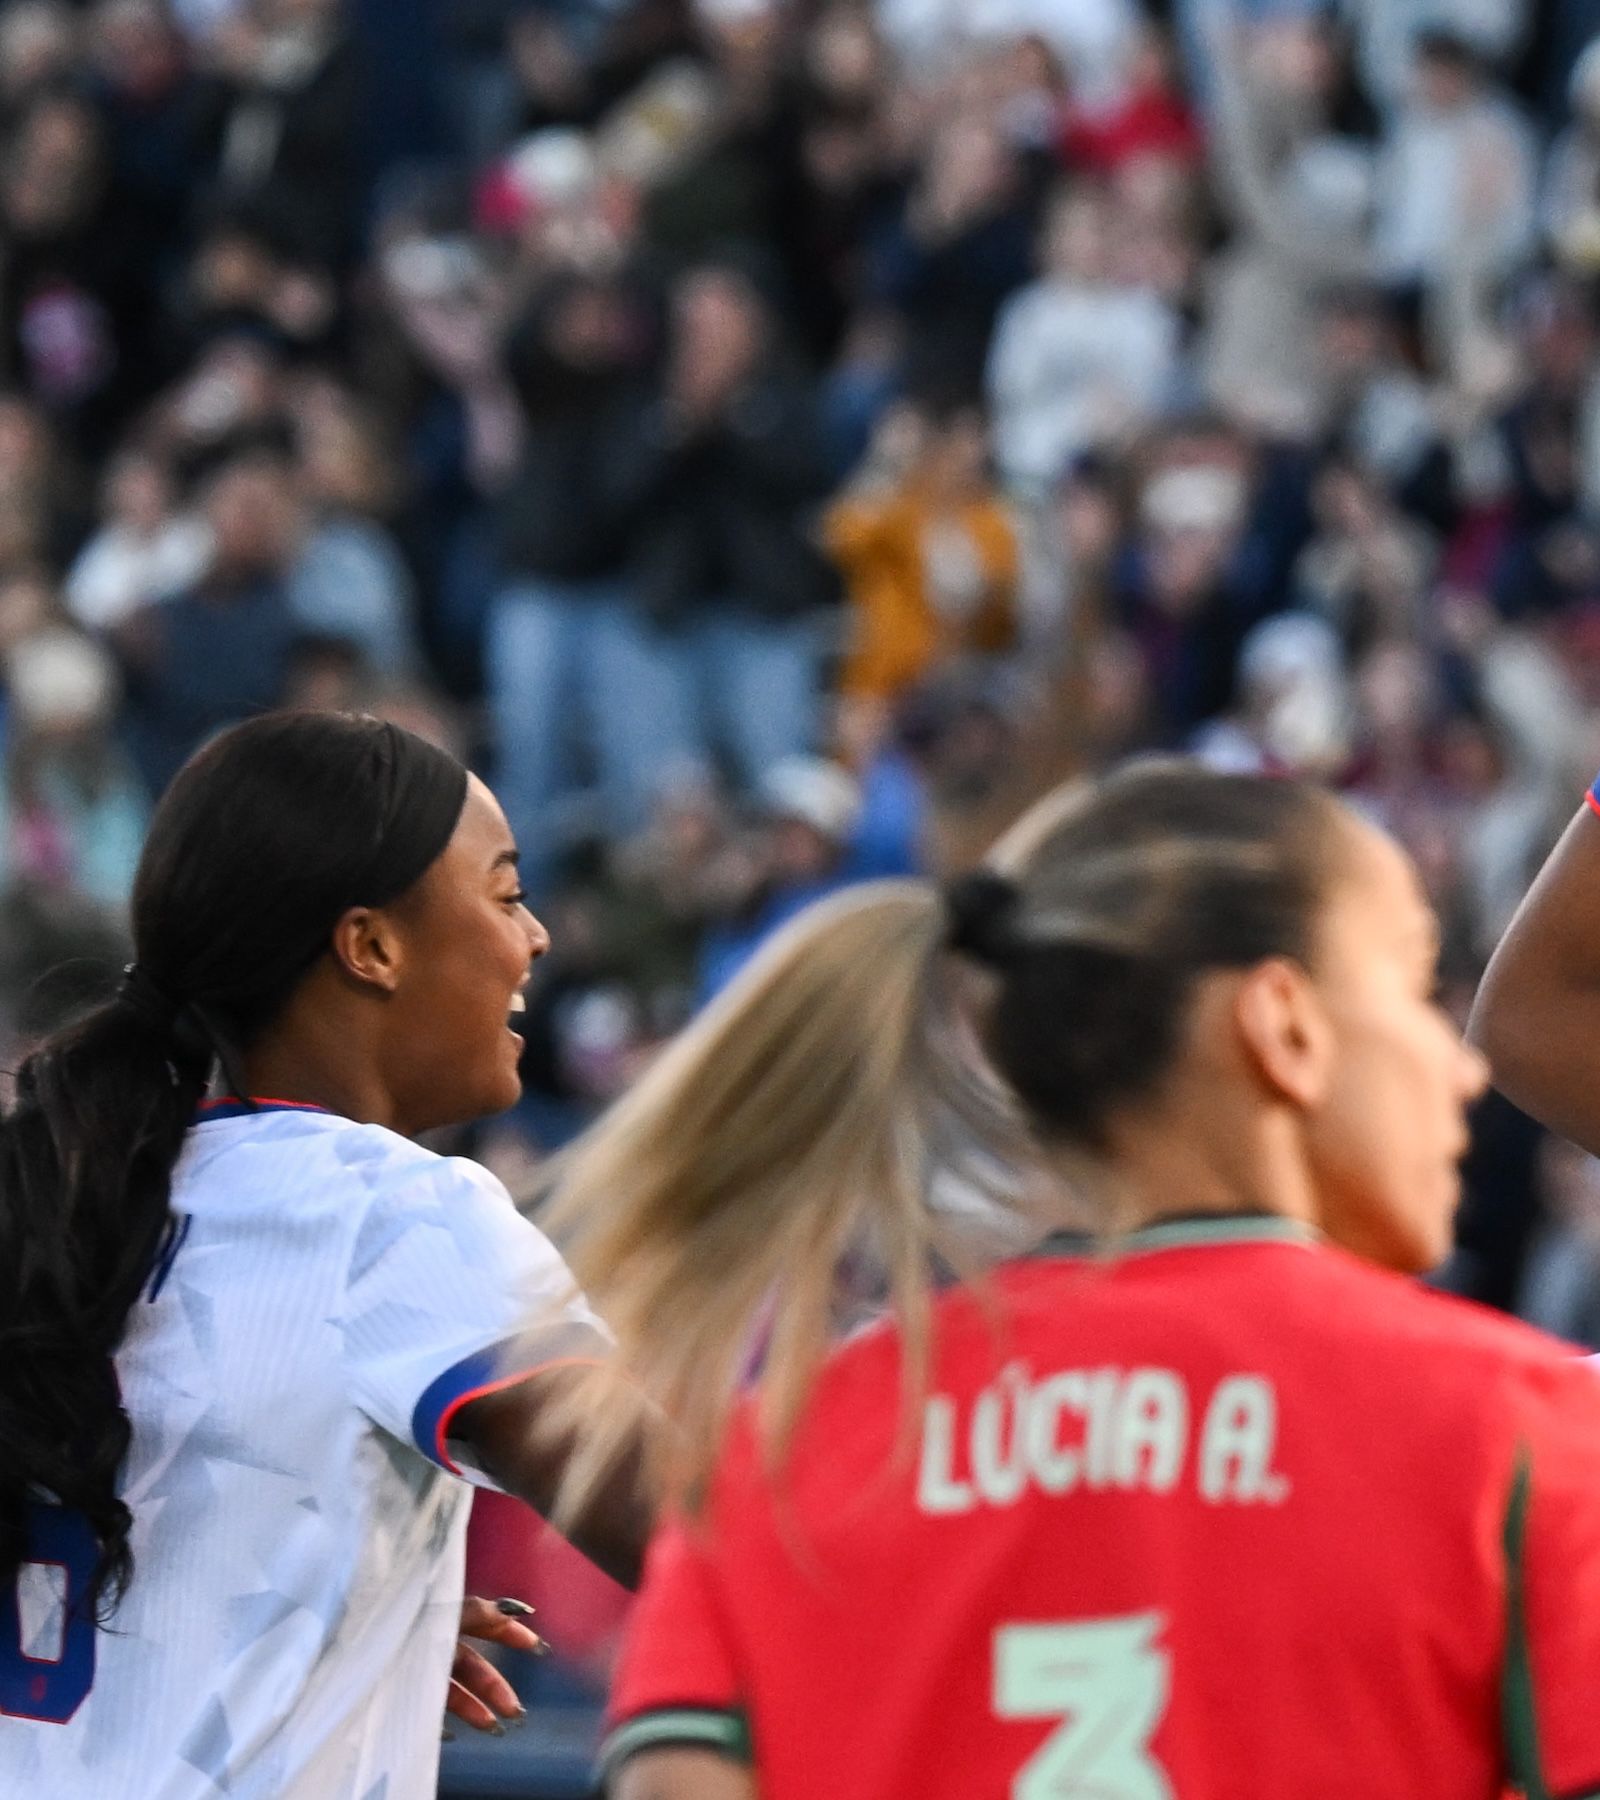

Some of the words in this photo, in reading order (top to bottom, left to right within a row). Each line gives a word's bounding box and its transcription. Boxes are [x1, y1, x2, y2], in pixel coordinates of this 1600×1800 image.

[918, 1363, 1190, 1515] LÚCIA
[1199, 1374, 1291, 1507] A.
[992, 1610, 1176, 1800] 3
